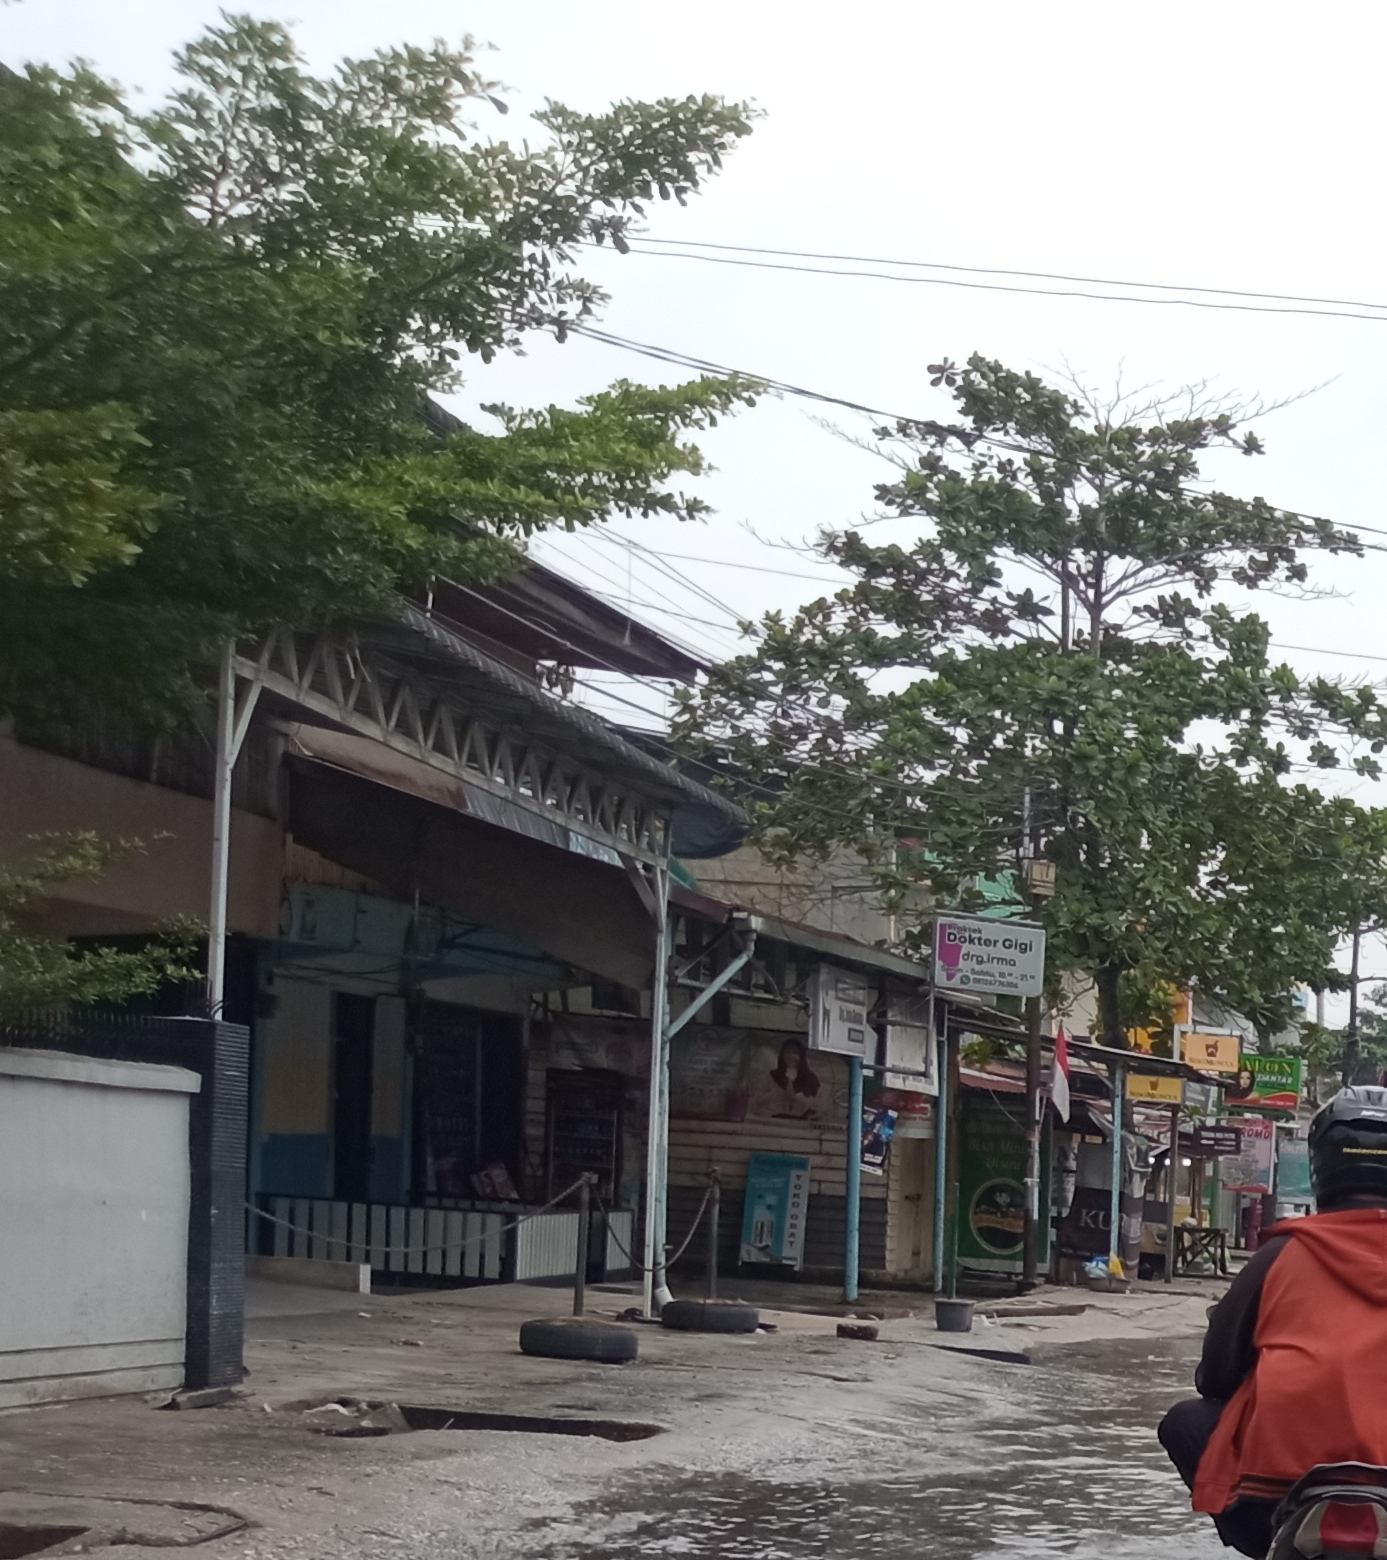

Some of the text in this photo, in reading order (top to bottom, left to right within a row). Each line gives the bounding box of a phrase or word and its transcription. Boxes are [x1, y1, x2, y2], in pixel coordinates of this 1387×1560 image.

[947, 932, 1033, 954] Dokter Gigi
[962, 951, 1017, 967] drg.irma
